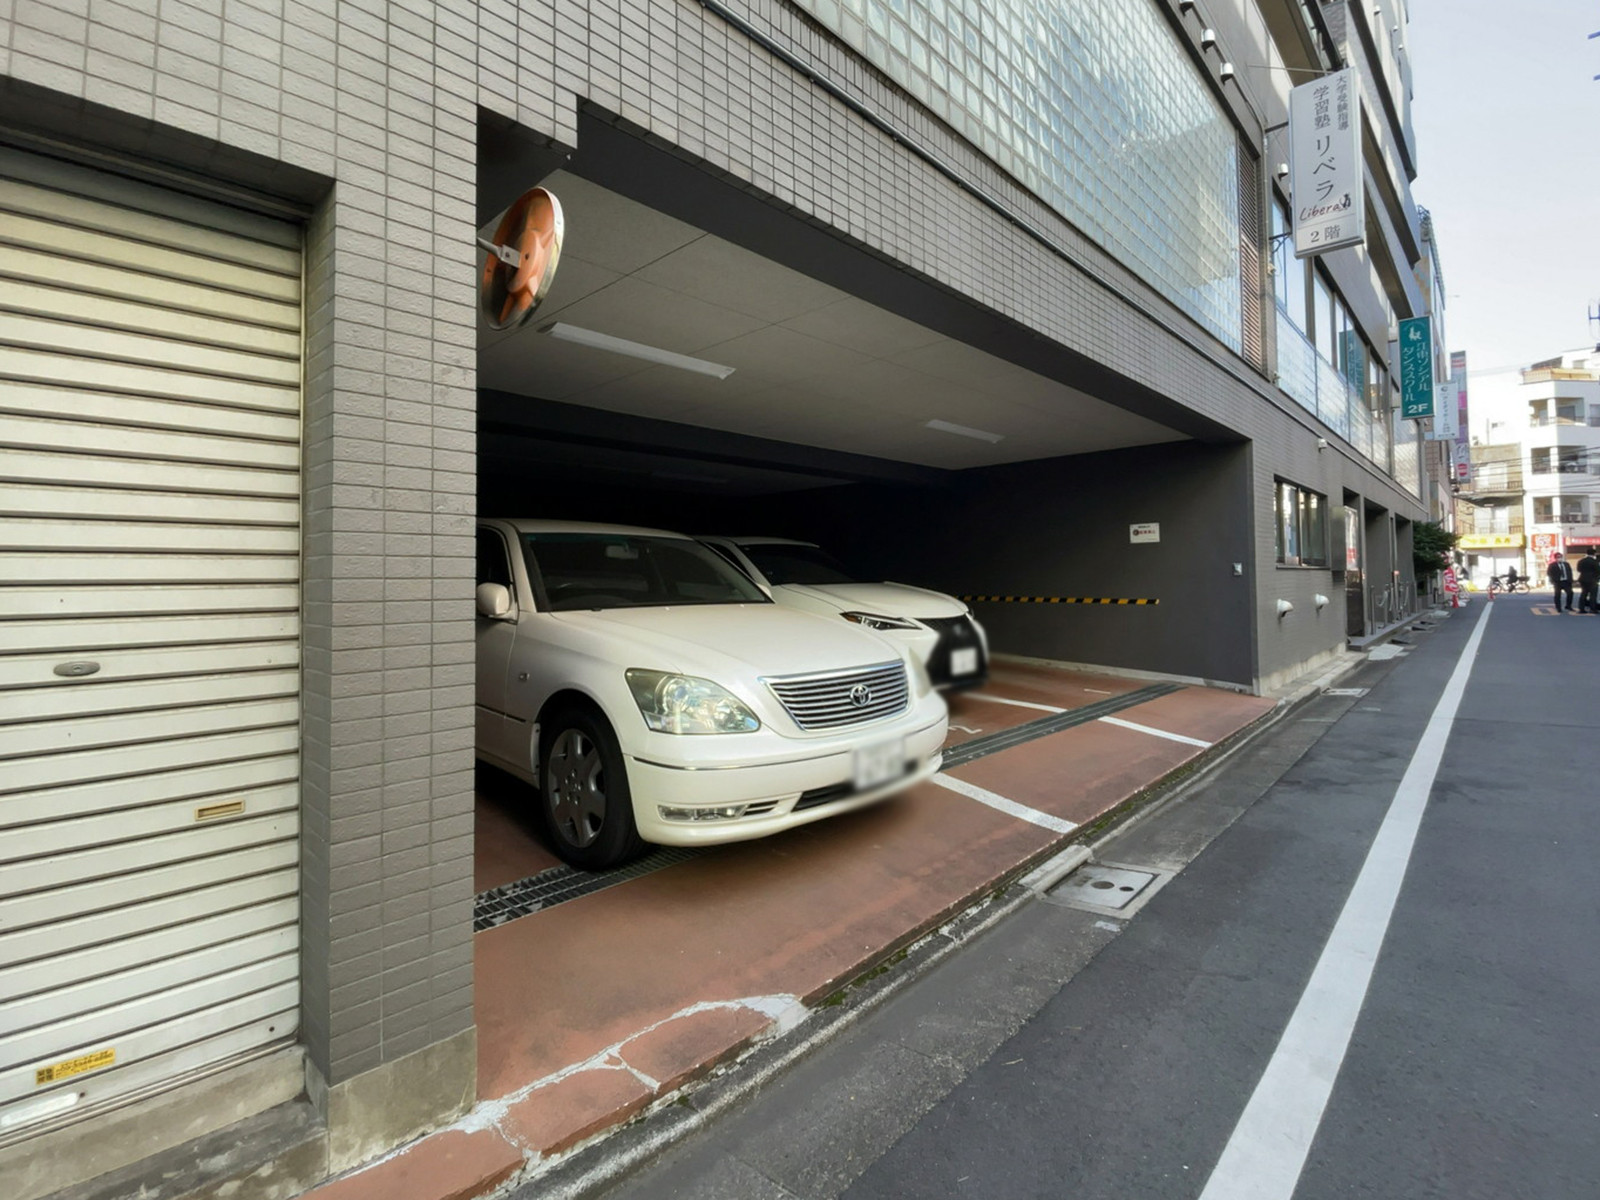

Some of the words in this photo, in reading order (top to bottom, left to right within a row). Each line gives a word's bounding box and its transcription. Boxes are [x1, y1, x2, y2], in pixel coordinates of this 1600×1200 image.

[1313, 85, 1331, 130] 学習塾
[1313, 135, 1336, 202] リベラ
[1299, 204, 1341, 221] Libera
[1403, 347, 1416, 401] ダンススクール
[1407, 403, 1428, 414] 2F
